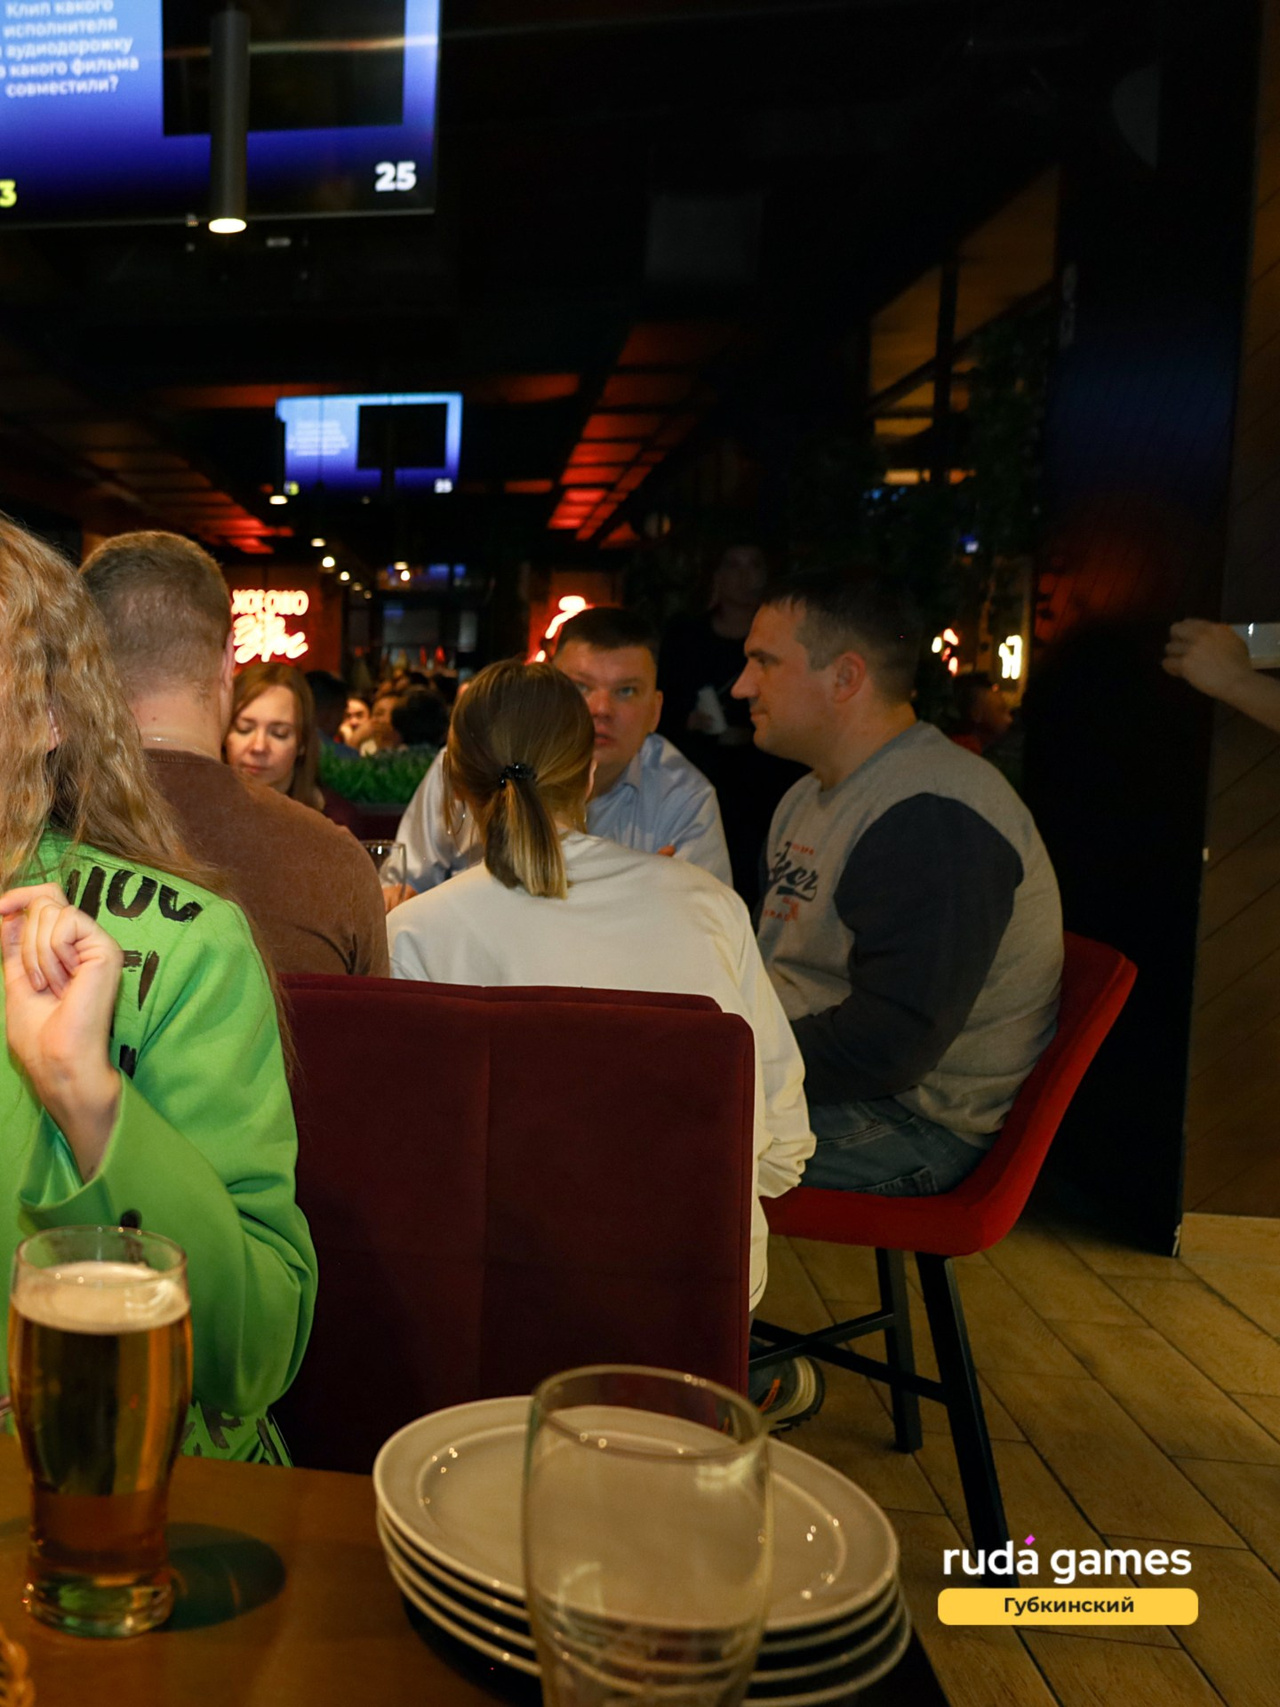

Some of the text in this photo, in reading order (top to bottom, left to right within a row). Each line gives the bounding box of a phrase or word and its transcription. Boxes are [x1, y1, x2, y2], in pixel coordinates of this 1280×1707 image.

[5, 0, 114, 18] Клип какого
[3, 17, 118, 38] исполнителя
[6, 37, 133, 61] аудиодорожку
[10, 61, 68, 77] какого
[71, 56, 139, 76] фильма
[5, 75, 119, 98] совместили?
[374, 161, 417, 191] 25
